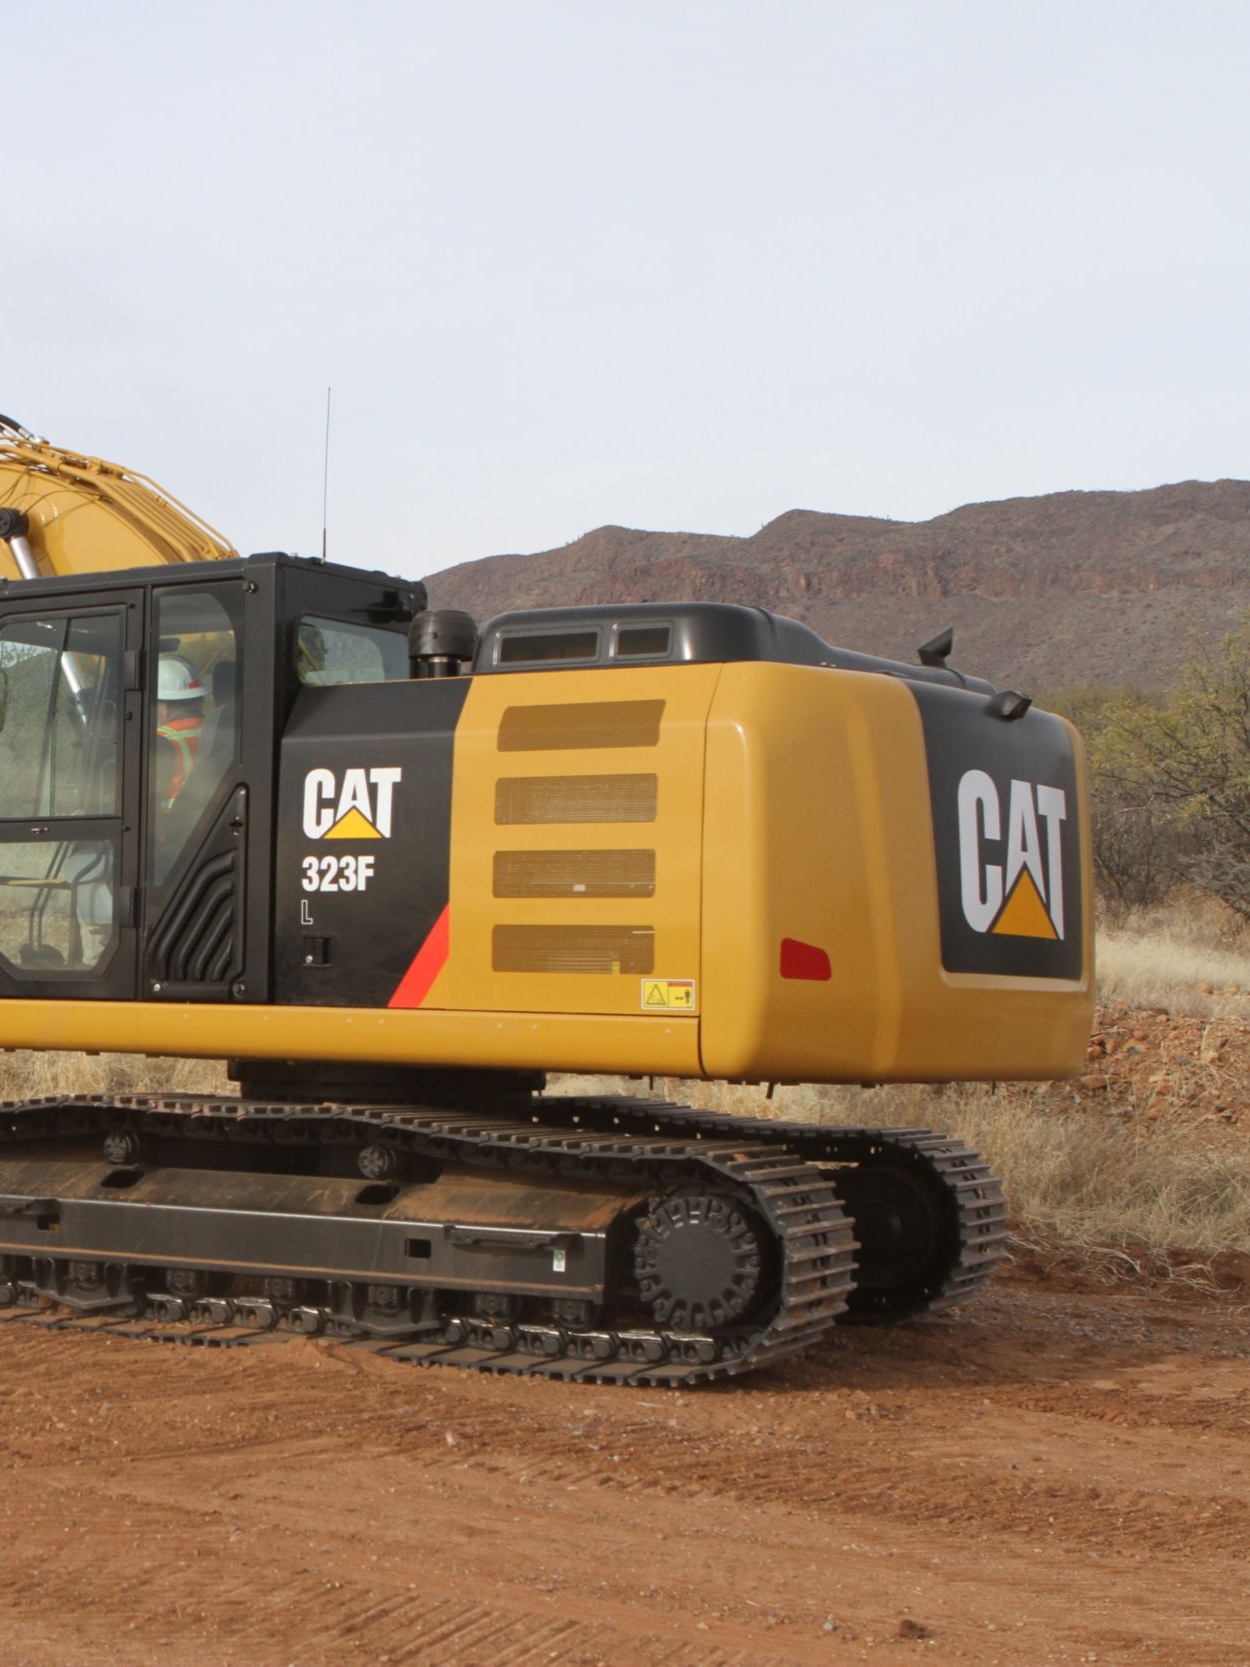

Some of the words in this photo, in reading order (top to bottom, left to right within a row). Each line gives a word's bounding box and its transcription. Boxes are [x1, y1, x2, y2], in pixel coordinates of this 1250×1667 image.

[302, 767, 402, 840] CAT
[301, 855, 375, 892] 323F
[957, 769, 1067, 941] CAT
[300, 899, 314, 925] L
